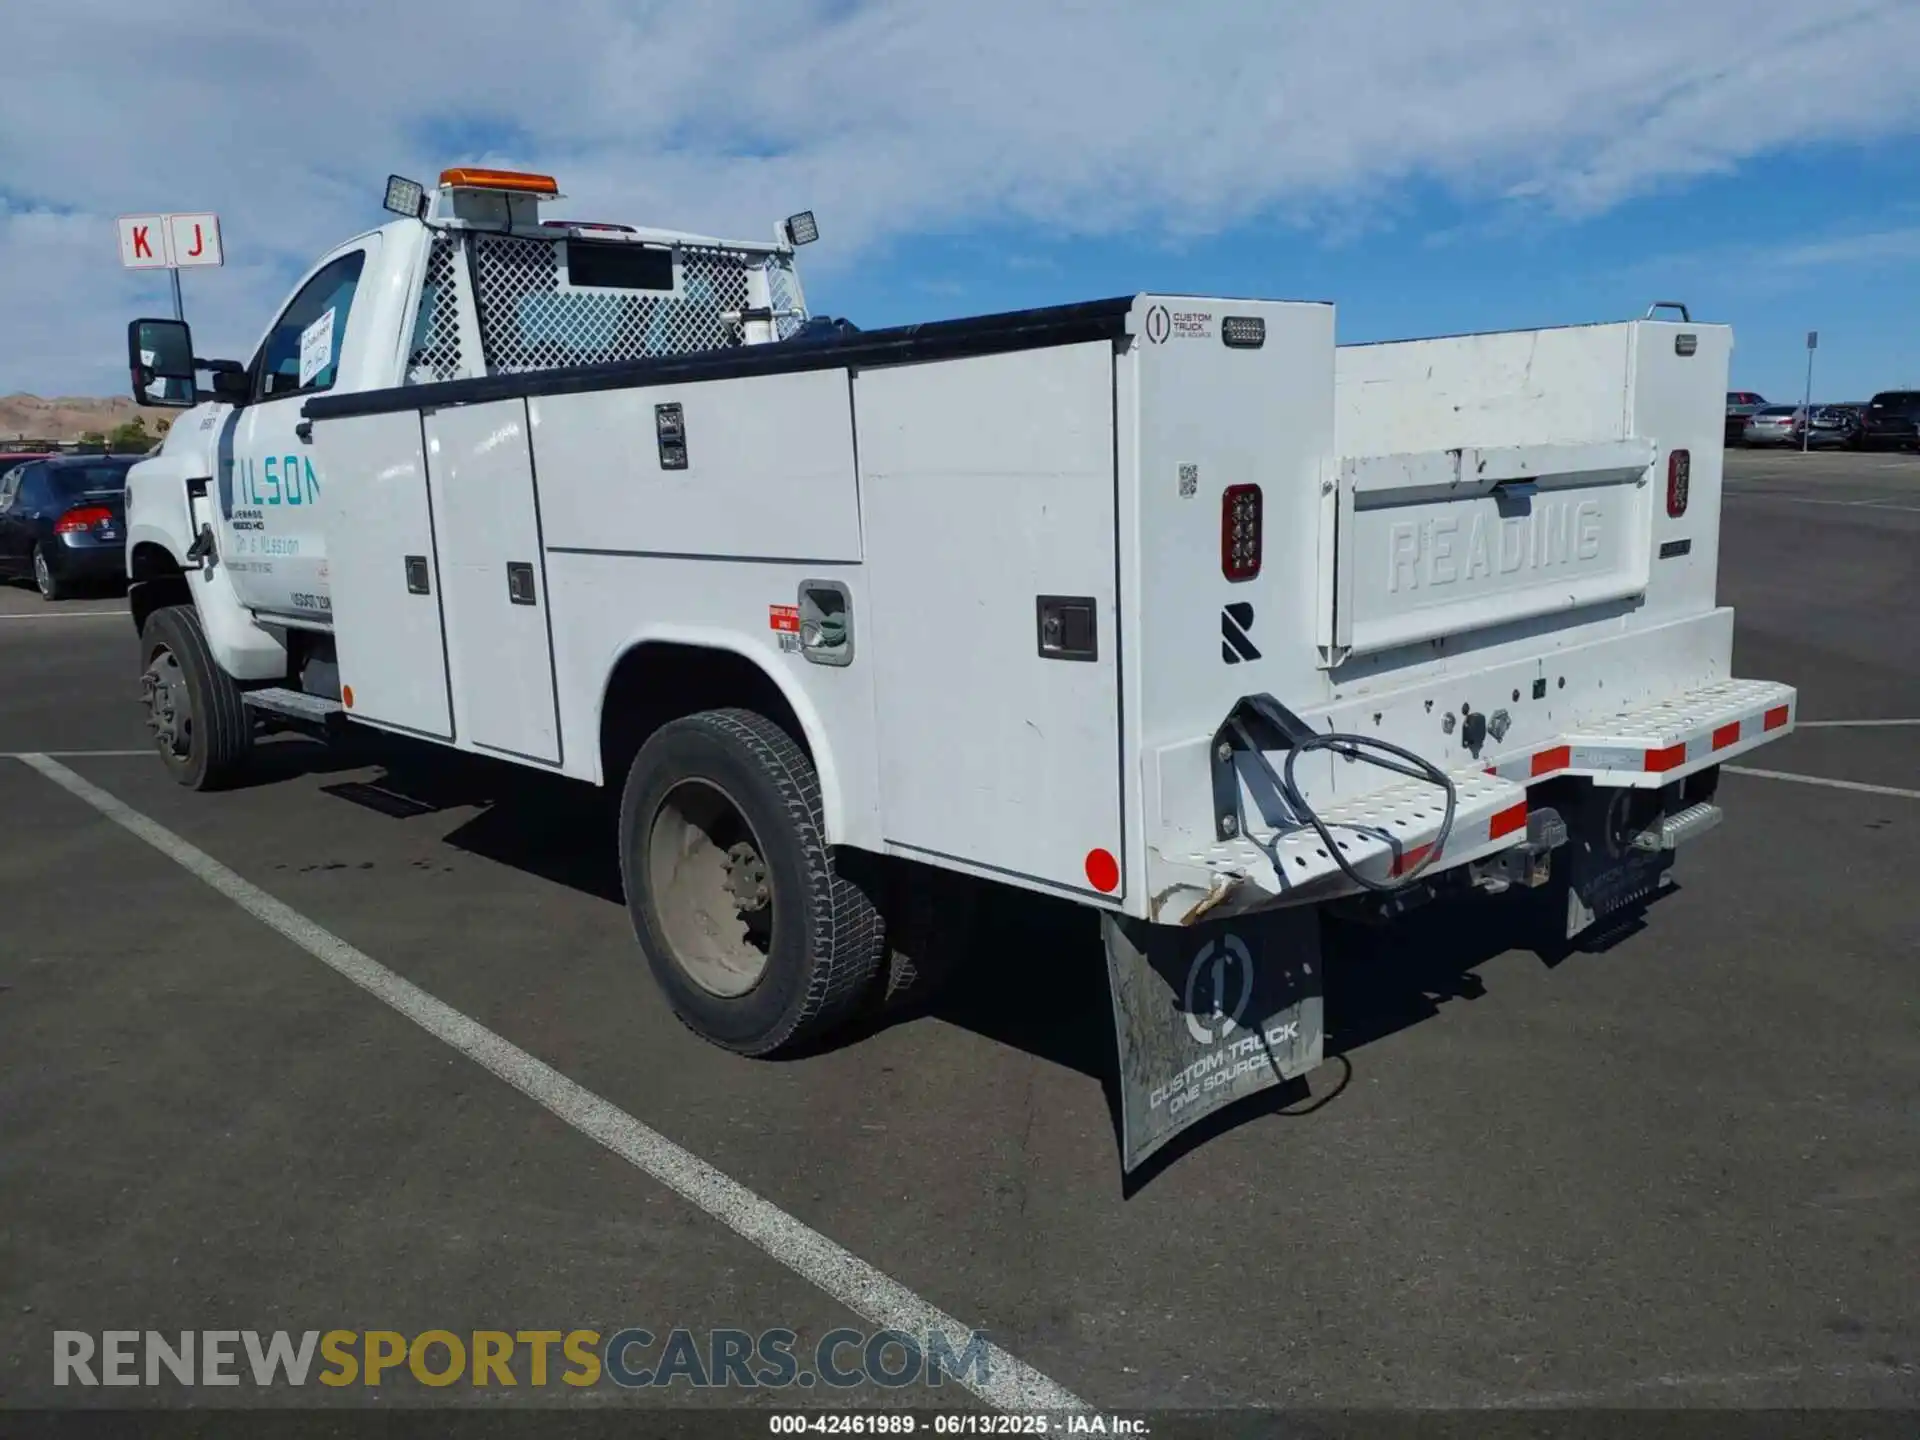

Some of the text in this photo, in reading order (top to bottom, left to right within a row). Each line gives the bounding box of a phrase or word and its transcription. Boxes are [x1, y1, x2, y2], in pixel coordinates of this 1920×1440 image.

[133, 224, 202, 258] K J
[1173, 312, 1212, 321] CUSTOM
[1173, 322, 1203, 331] TRUCK
[1387, 501, 1603, 593] READING
[1150, 1021, 1300, 1109] CUSTOM TRUCK
[1170, 1086, 1201, 1114] ONE
